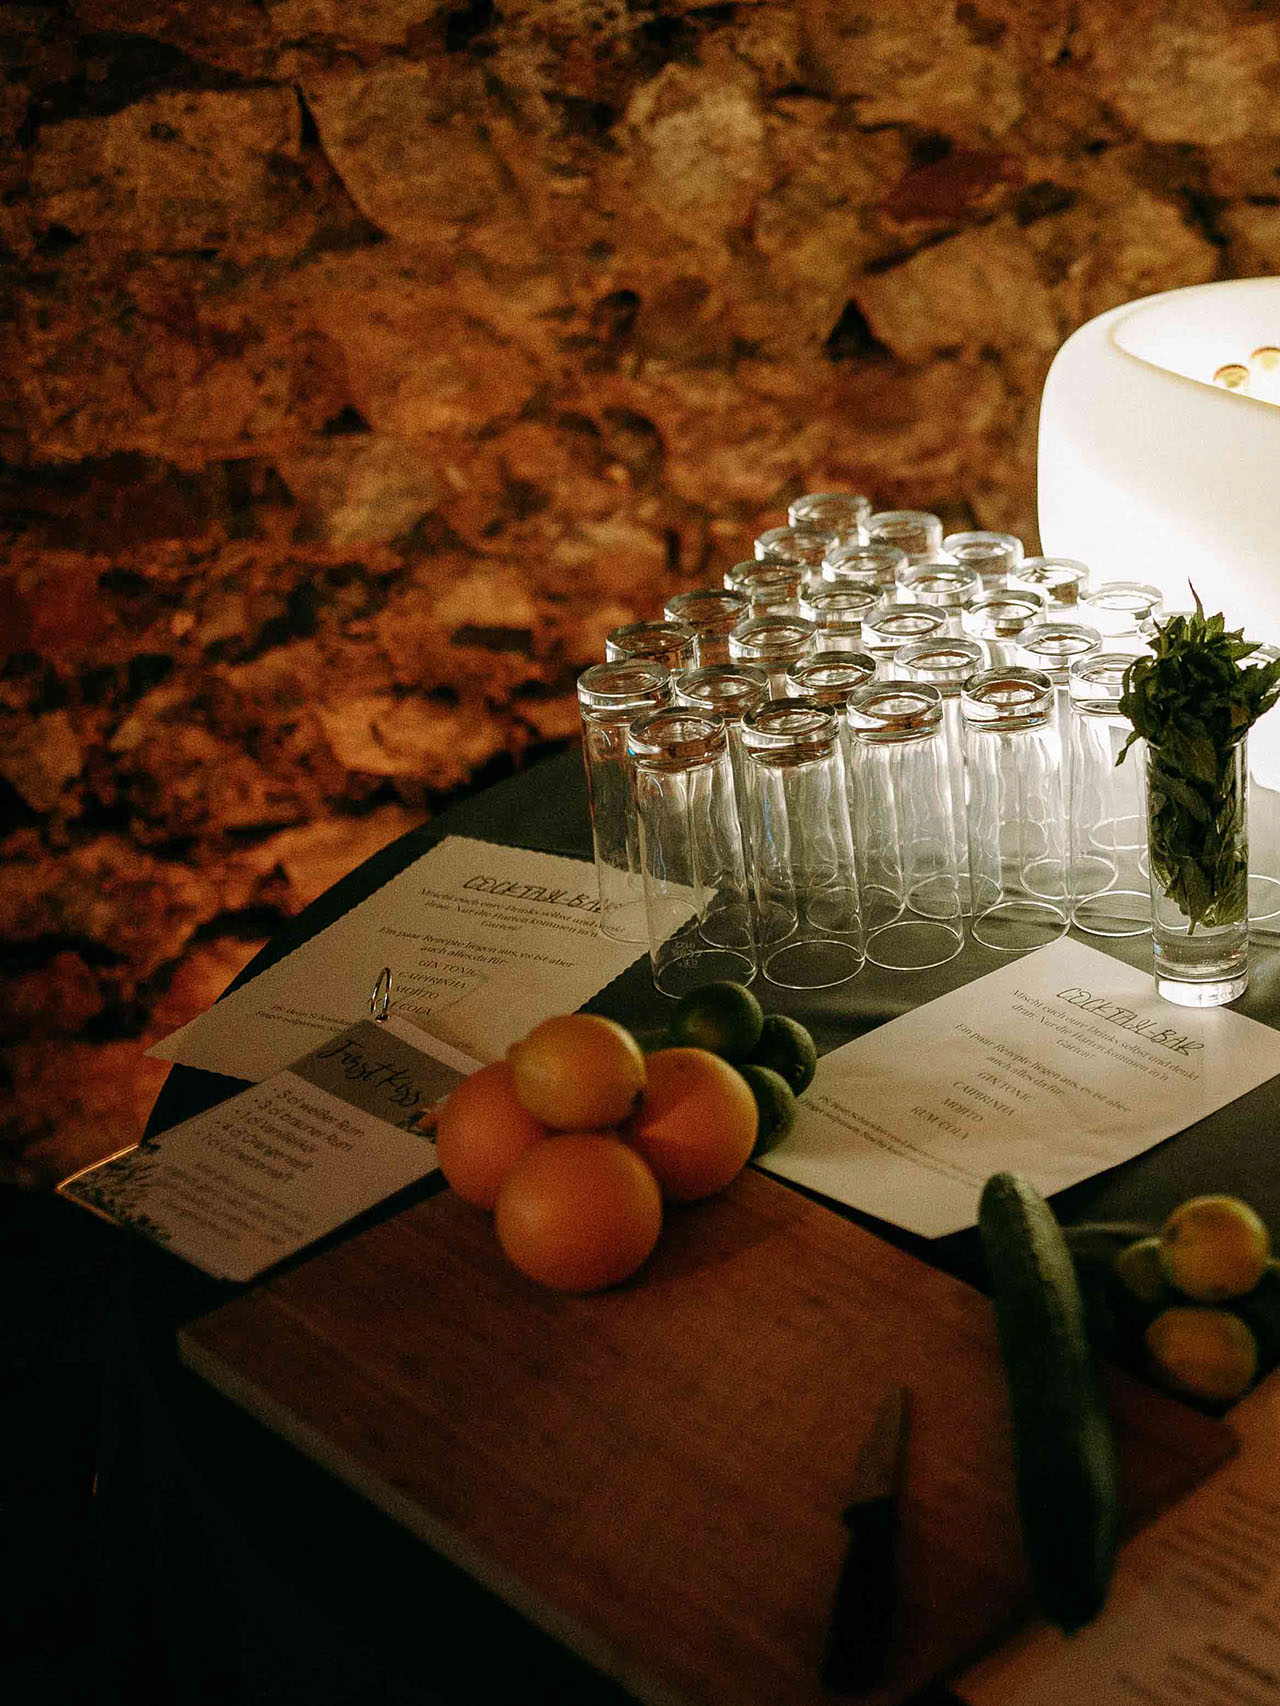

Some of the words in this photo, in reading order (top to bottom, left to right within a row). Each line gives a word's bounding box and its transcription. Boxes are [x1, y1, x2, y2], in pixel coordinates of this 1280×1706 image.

[417, 958, 443, 968] GIN
[439, 963, 480, 976] TONIC
[547, 957, 577, 967] aber
[391, 984, 442, 999] MOJITO
[397, 969, 469, 989] CAIPIRINHA
[396, 1003, 434, 1015] COLA
[1055, 985, 1205, 1055] COCKTAIL-BAR
[1009, 989, 1046, 1007] Mischt
[1040, 1004, 1068, 1018] euch
[1085, 1026, 1123, 1044] Drinks
[1146, 1055, 1172, 1067] und
[1167, 1064, 1202, 1080] denkt
[1036, 1016, 1058, 1027] Nur
[1053, 1025, 1072, 1034] die
[1069, 1032, 1108, 1051] Harten
[1102, 1048, 1152, 1071] kommen
[954, 1023, 975, 1034] Ein
[968, 1032, 997, 1046] paar
[990, 1044, 1036, 1065] Rezepte
[1027, 1061, 1065, 1079] liegen
[984, 1055, 1015, 1070] auch
[1009, 1067, 1038, 1080] alles
[947, 1081, 1021, 1115] CAIPIRINHA
[975, 1071, 1003, 1084] GIN
[995, 1082, 1038, 1102] TONIC
[907, 1106, 941, 1122] RUM
[933, 1119, 974, 1139] COLA
[938, 1098, 988, 1121] MOJITO
